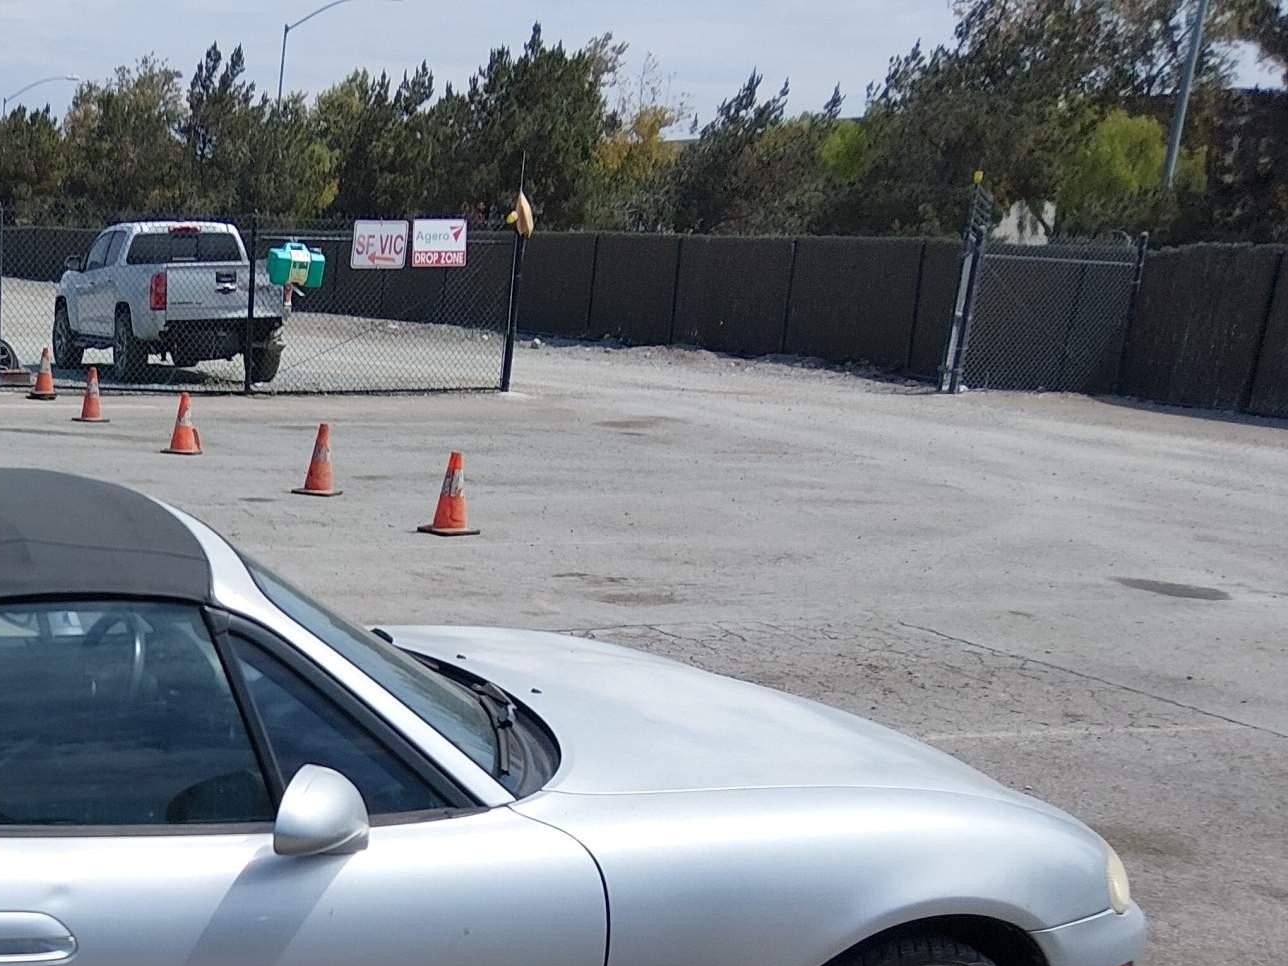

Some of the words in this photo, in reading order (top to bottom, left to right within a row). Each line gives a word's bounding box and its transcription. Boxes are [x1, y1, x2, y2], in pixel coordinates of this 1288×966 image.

[416, 231, 449, 244] Agero
[380, 234, 404, 255] VIC
[415, 252, 438, 264] DROP
[440, 252, 464, 264] ZONE
